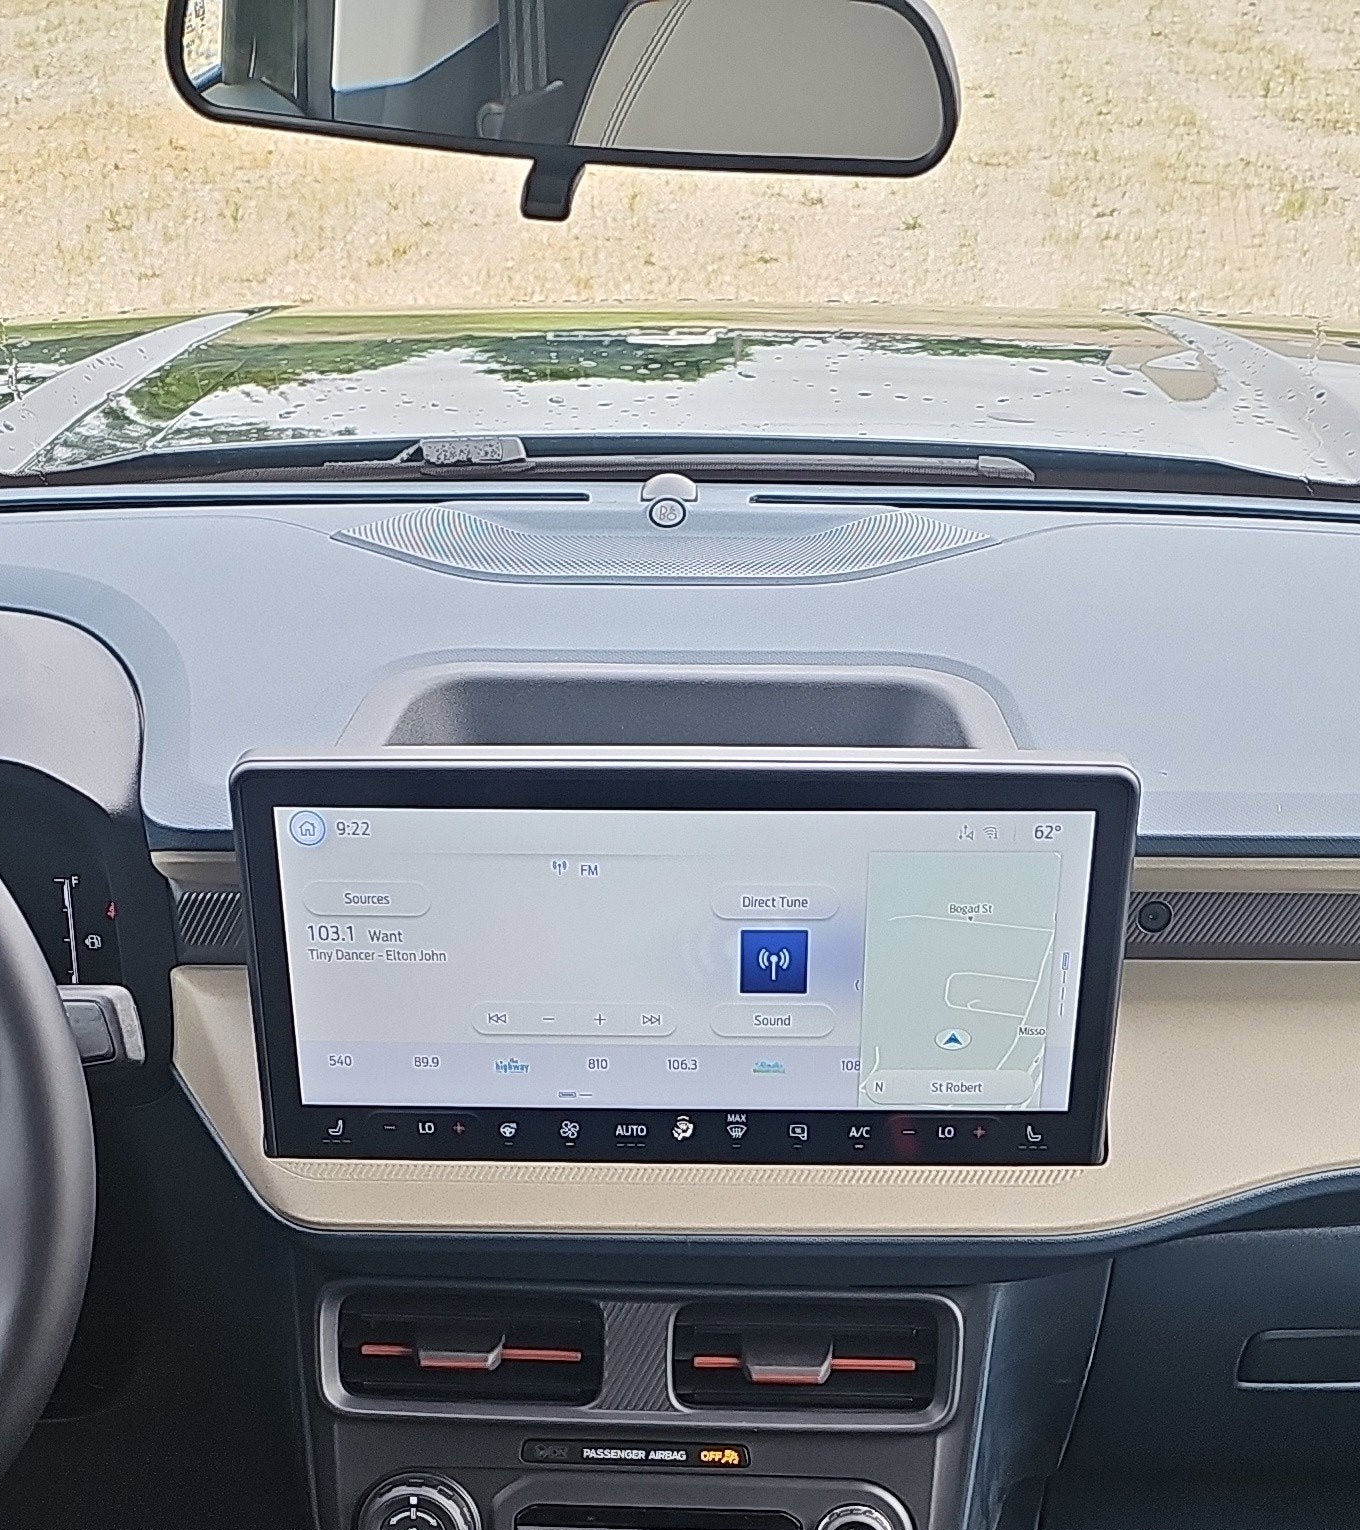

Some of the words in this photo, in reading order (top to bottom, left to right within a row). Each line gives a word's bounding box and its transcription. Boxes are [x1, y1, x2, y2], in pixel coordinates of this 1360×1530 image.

[336, 821, 370, 836] 9:22
[1034, 825, 1062, 840] 62°
[580, 864, 599, 877] FM
[344, 893, 390, 905] Sources
[742, 896, 777, 909] Direct
[779, 897, 808, 909] Tune
[949, 904, 978, 916] Bogad
[981, 904, 993, 915] St
[307, 925, 356, 943] 103.1
[368, 930, 403, 943] Want
[308, 949, 334, 963] Tiny
[336, 949, 376, 962] Dancer
[386, 950, 417, 962] Elton
[418, 950, 447, 962] John
[754, 1014, 791, 1027] Sound
[1019, 1027, 1046, 1036] Misso
[329, 1056, 352, 1067] 540
[414, 1056, 439, 1068] 89.9
[588, 1058, 608, 1070] 810
[667, 1059, 698, 1071] 106.3
[842, 1060, 860, 1071] 108
[875, 1082, 884, 1093] N
[931, 1082, 943, 1093] St
[946, 1082, 983, 1094] Robert
[727, 1114, 746, 1123] MAX
[419, 1122, 435, 1134] LO
[615, 1124, 646, 1137] AUTO
[849, 1126, 870, 1139] A/C
[939, 1127, 954, 1139] LO
[583, 1449, 645, 1460] PASSENGER
[648, 1451, 686, 1461] AIRBAG
[700, 1451, 722, 1462] OFF
